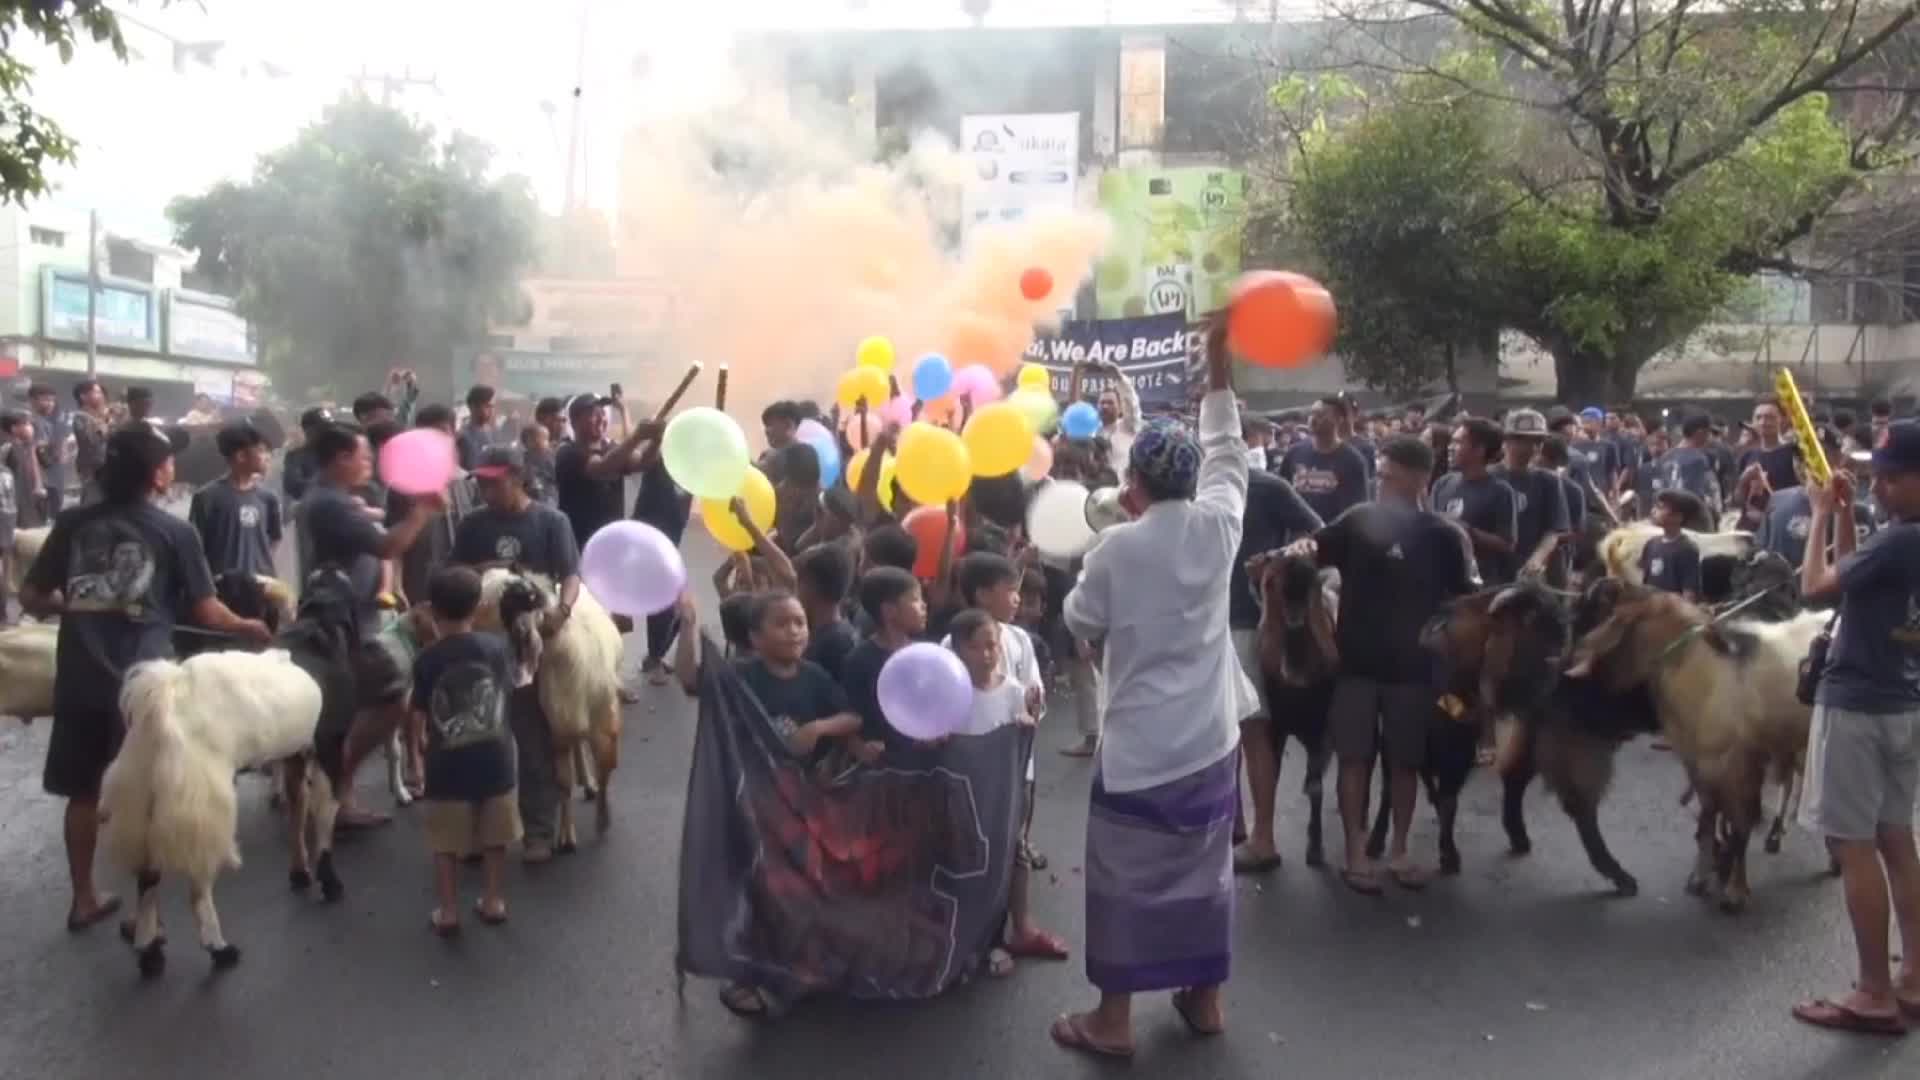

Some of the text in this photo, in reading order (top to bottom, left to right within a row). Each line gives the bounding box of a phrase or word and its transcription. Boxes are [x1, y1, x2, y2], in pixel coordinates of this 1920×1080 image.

[1050, 339, 1085, 362] We
[1087, 340, 1127, 362] Are
[1131, 329, 1185, 360] Back
